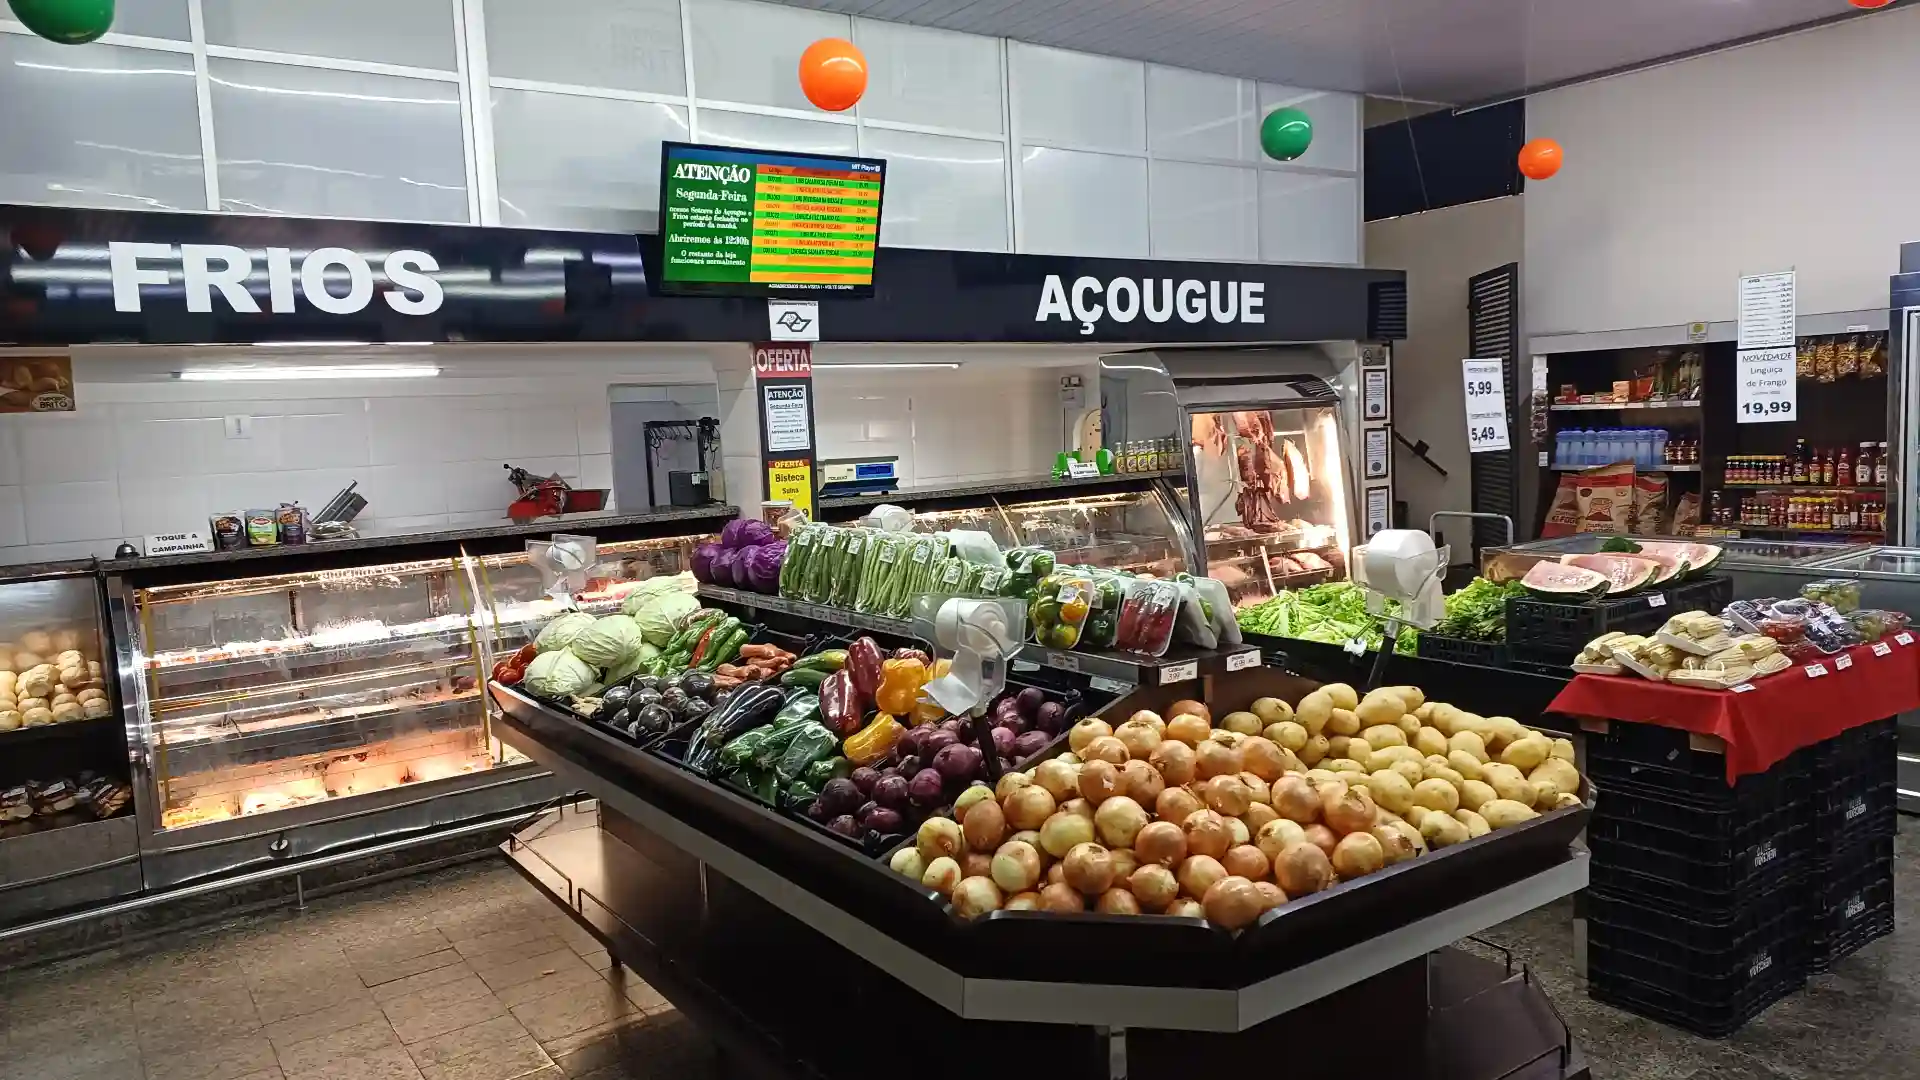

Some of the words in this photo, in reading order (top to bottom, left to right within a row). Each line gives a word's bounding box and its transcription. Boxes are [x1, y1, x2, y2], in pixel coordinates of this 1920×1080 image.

[672, 163, 751, 185] ATENÇÃO
[676, 187, 748, 202] Segunda-Feira
[668, 234, 711, 244] Abriremos
[108, 240, 444, 316] FRIOS
[1035, 274, 1265, 335] AÇOUGUE
[756, 348, 810, 372] OFERTA
[1742, 352, 1792, 362] NOVIDADE
[1750, 366, 1783, 375] Linguiça
[1758, 378, 1787, 387] Frango
[768, 388, 803, 400] ATENÇÃO
[1468, 381, 1492, 397] 5,99
[1742, 401, 1792, 416] 19,99
[1472, 427, 1495, 444] 5,49
[774, 460, 804, 468] OFERTA
[775, 473, 805, 482] Bisteca
[155, 534, 187, 542] TOQUE
[152, 543, 205, 552] CAMPAINHA
